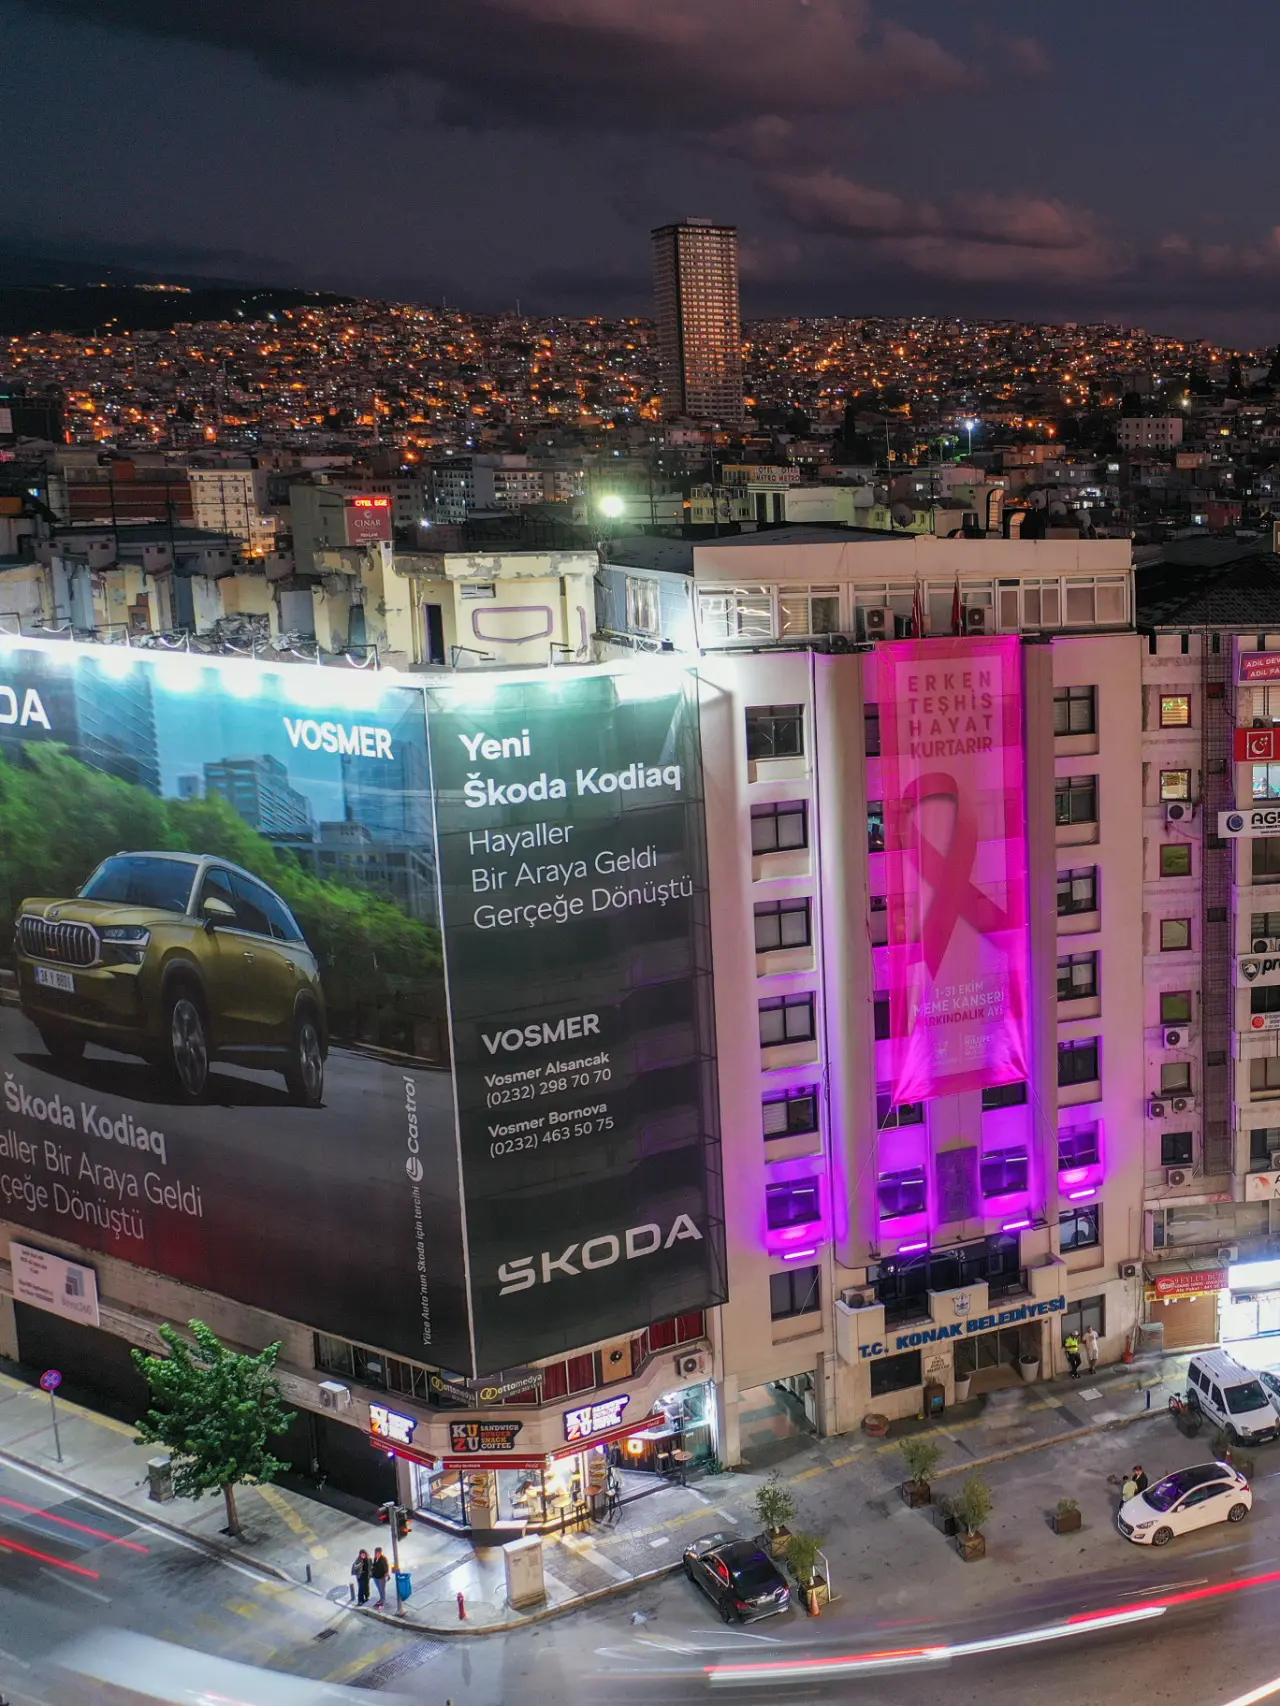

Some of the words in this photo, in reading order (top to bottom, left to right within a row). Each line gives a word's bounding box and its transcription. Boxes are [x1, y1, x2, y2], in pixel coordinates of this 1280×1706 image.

[908, 671, 990, 692] ERKEN
[908, 689, 992, 716] TEŞHİS
[283, 717, 394, 760] VOSMER
[909, 714, 993, 736] HAYAT
[458, 729, 531, 761] Yeni
[910, 737, 993, 759] KURTARIR
[463, 772, 567, 808] Škoda
[576, 762, 681, 795] Kodiaq
[469, 822, 574, 856] Hayaller
[471, 868, 507, 892] Bir
[515, 860, 587, 886] Araya
[594, 845, 657, 874] Geldi
[474, 894, 584, 929] Gerçeğe
[591, 875, 693, 912] Dönüştü
[958, 980, 983, 994] EKİM
[913, 1000, 948, 1016] MEME
[482, 1013, 600, 1054] VOSMER
[484, 1066, 541, 1088] Vosmer
[545, 1052, 610, 1075] Alsancak
[487, 1084, 536, 1108] (0232)
[539, 1079, 567, 1095] 298
[571, 1073, 589, 1088] 70
[593, 1069, 611, 1083] 70
[4, 1071, 75, 1129] Škoda
[81, 1102, 167, 1164] Kodiaq
[402, 1075, 419, 1154] Castrol
[488, 1116, 545, 1138] Vosmer
[549, 1103, 607, 1125] Bornova
[490, 1133, 538, 1158] (0232)
[542, 1127, 571, 1144] 463
[574, 1122, 593, 1137] 50
[596, 1117, 614, 1131] 75
[44, 1140, 72, 1175] Bir
[78, 1152, 139, 1200] Araya
[144, 1172, 203, 1217] Geldi
[53, 1183, 144, 1240] Dönüştü
[412, 1186, 422, 1219] tercihi
[423, 1321, 432, 1346] Yüce
[858, 1343, 889, 1358] T.C.
[896, 1323, 962, 1349] KONAK
[967, 1295, 1066, 1332] BELEDİYESİ
[498, 1374, 542, 1394] ottomedya
[452, 1424, 479, 1437] KU
[454, 1437, 479, 1450] ZU
